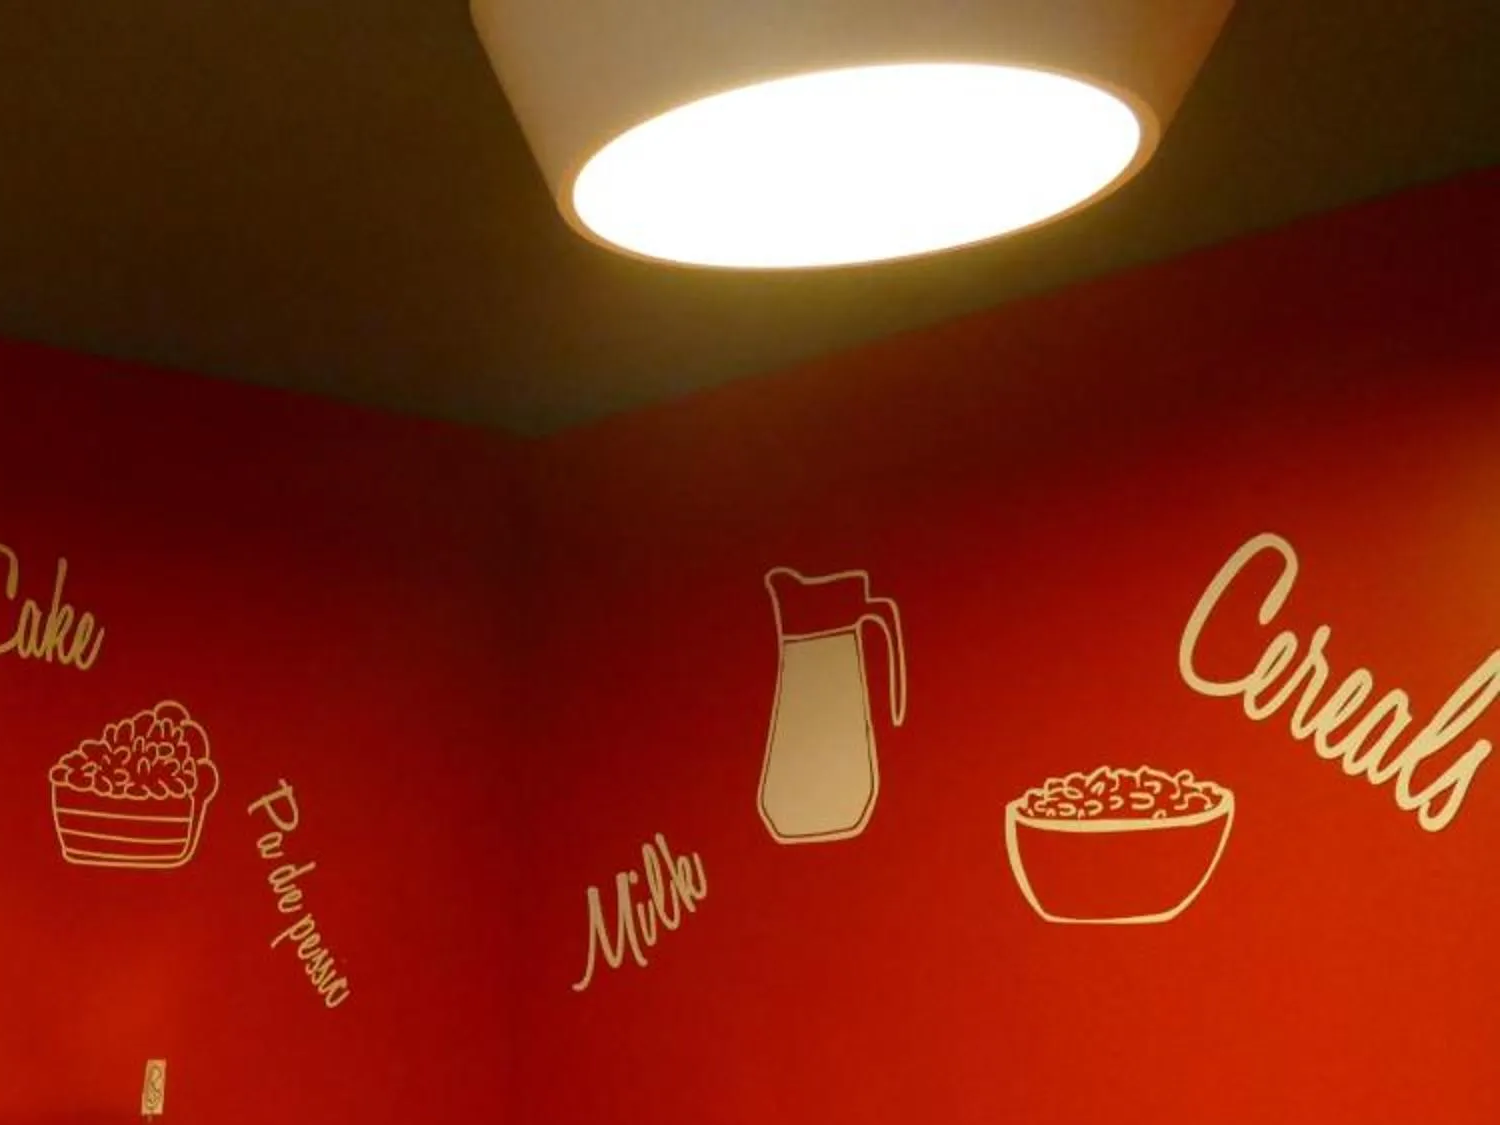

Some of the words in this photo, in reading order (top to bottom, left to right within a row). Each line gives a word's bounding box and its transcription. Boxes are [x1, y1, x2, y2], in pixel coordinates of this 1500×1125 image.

[1179, 531, 1500, 833] Cereals
[247, 778, 299, 860] Pa
[267, 861, 317, 914] de
[571, 831, 708, 992] Milk
